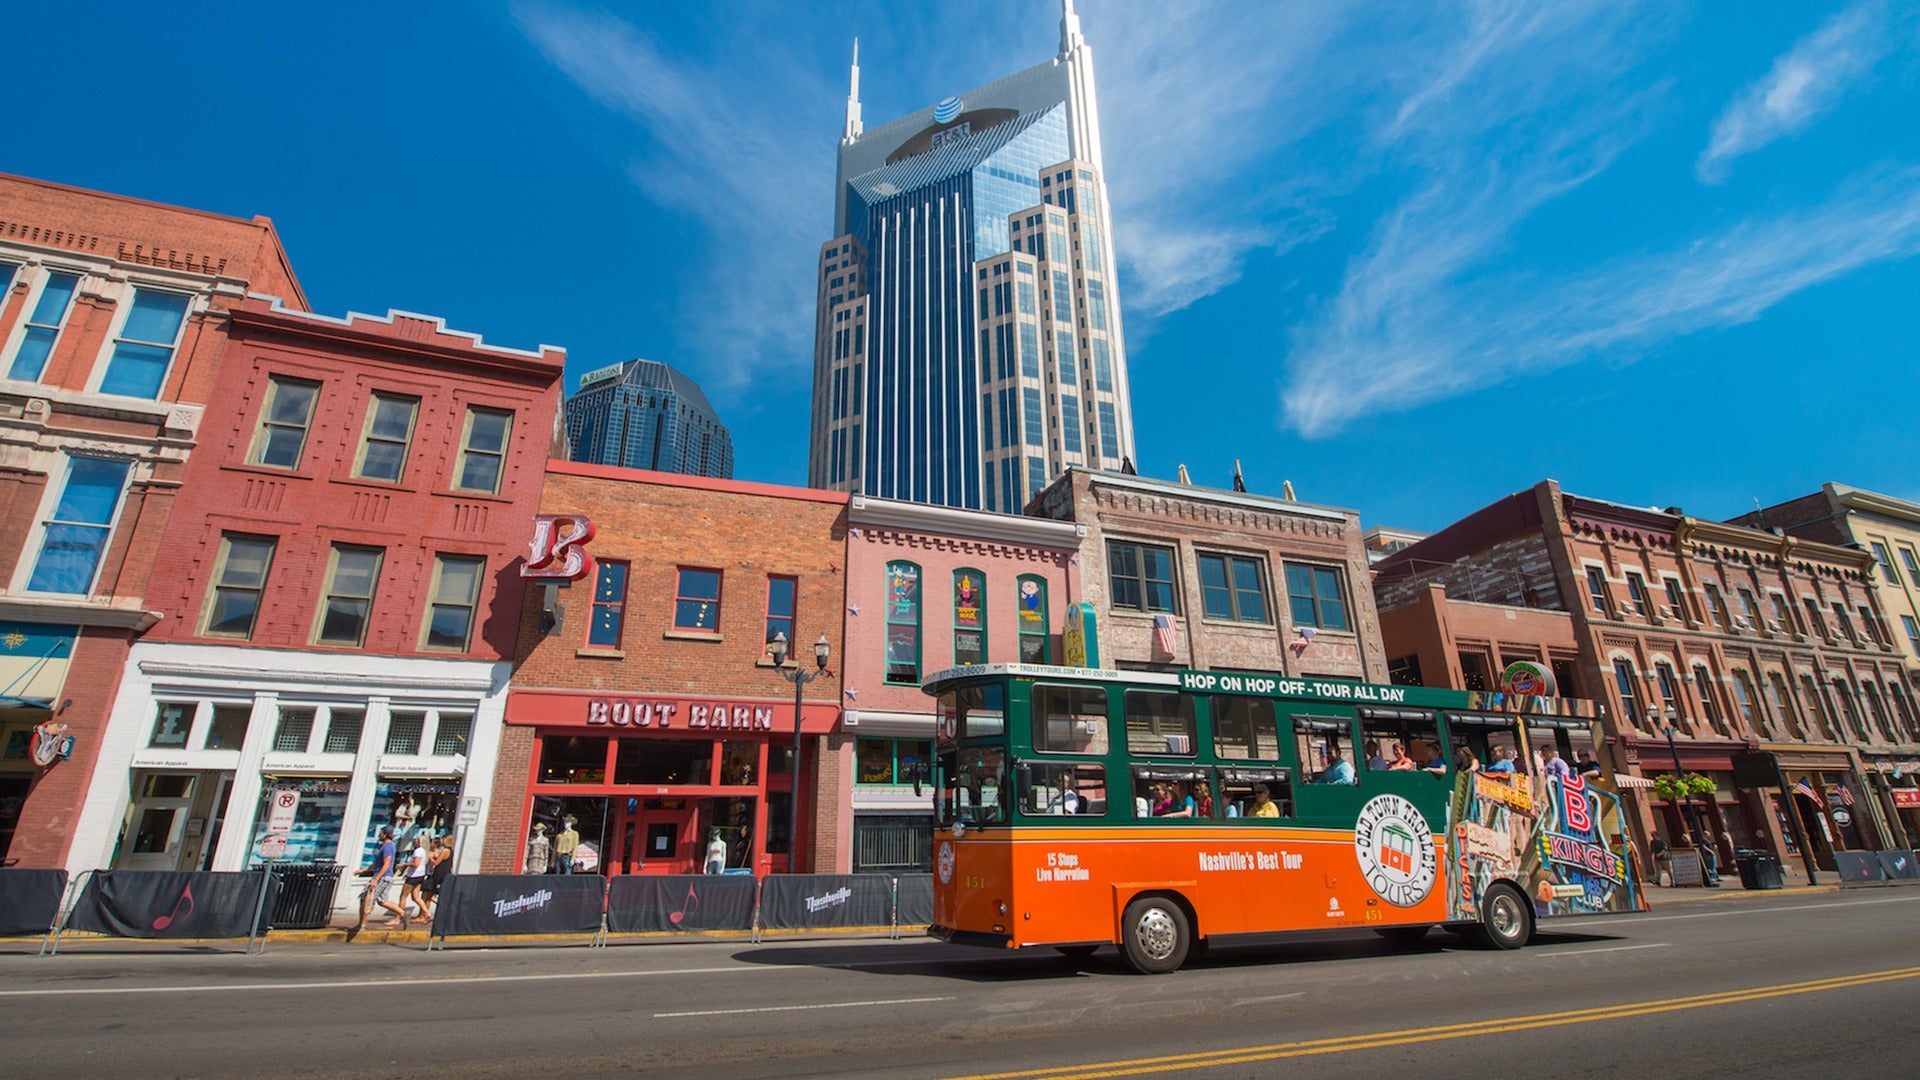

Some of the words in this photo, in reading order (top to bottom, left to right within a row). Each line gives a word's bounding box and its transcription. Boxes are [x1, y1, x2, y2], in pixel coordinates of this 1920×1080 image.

[932, 122, 969, 147] at&t
[520, 515, 596, 581] B
[1020, 665, 1076, 675] TROLLEYTOURS.COM
[1184, 673, 1216, 689] HOP
[1221, 676, 1242, 691] ON
[1246, 678, 1276, 693] HOP
[1354, 687, 1378, 700] ALL
[1381, 689, 1405, 702] DAY
[588, 699, 677, 727] BOOT
[688, 704, 773, 730] BARN
[1357, 817, 1373, 848] OLD
[1366, 797, 1399, 821] TOWN
[1403, 803, 1435, 875] TROLLEY
[1047, 853, 1056, 866] 15
[1058, 853, 1078, 868] Stops
[1199, 851, 1255, 871] Nashville's
[1257, 851, 1279, 870] Best
[1281, 851, 1302, 870] Tour
[964, 877, 985, 889] 451
[1036, 868, 1052, 882] Live
[1054, 867, 1089, 881] Narration
[1366, 859, 1425, 904] TOURS
[493, 889, 552, 918] Nashville
[805, 886, 851, 913] Nashville
[1365, 910, 1382, 921] 451
